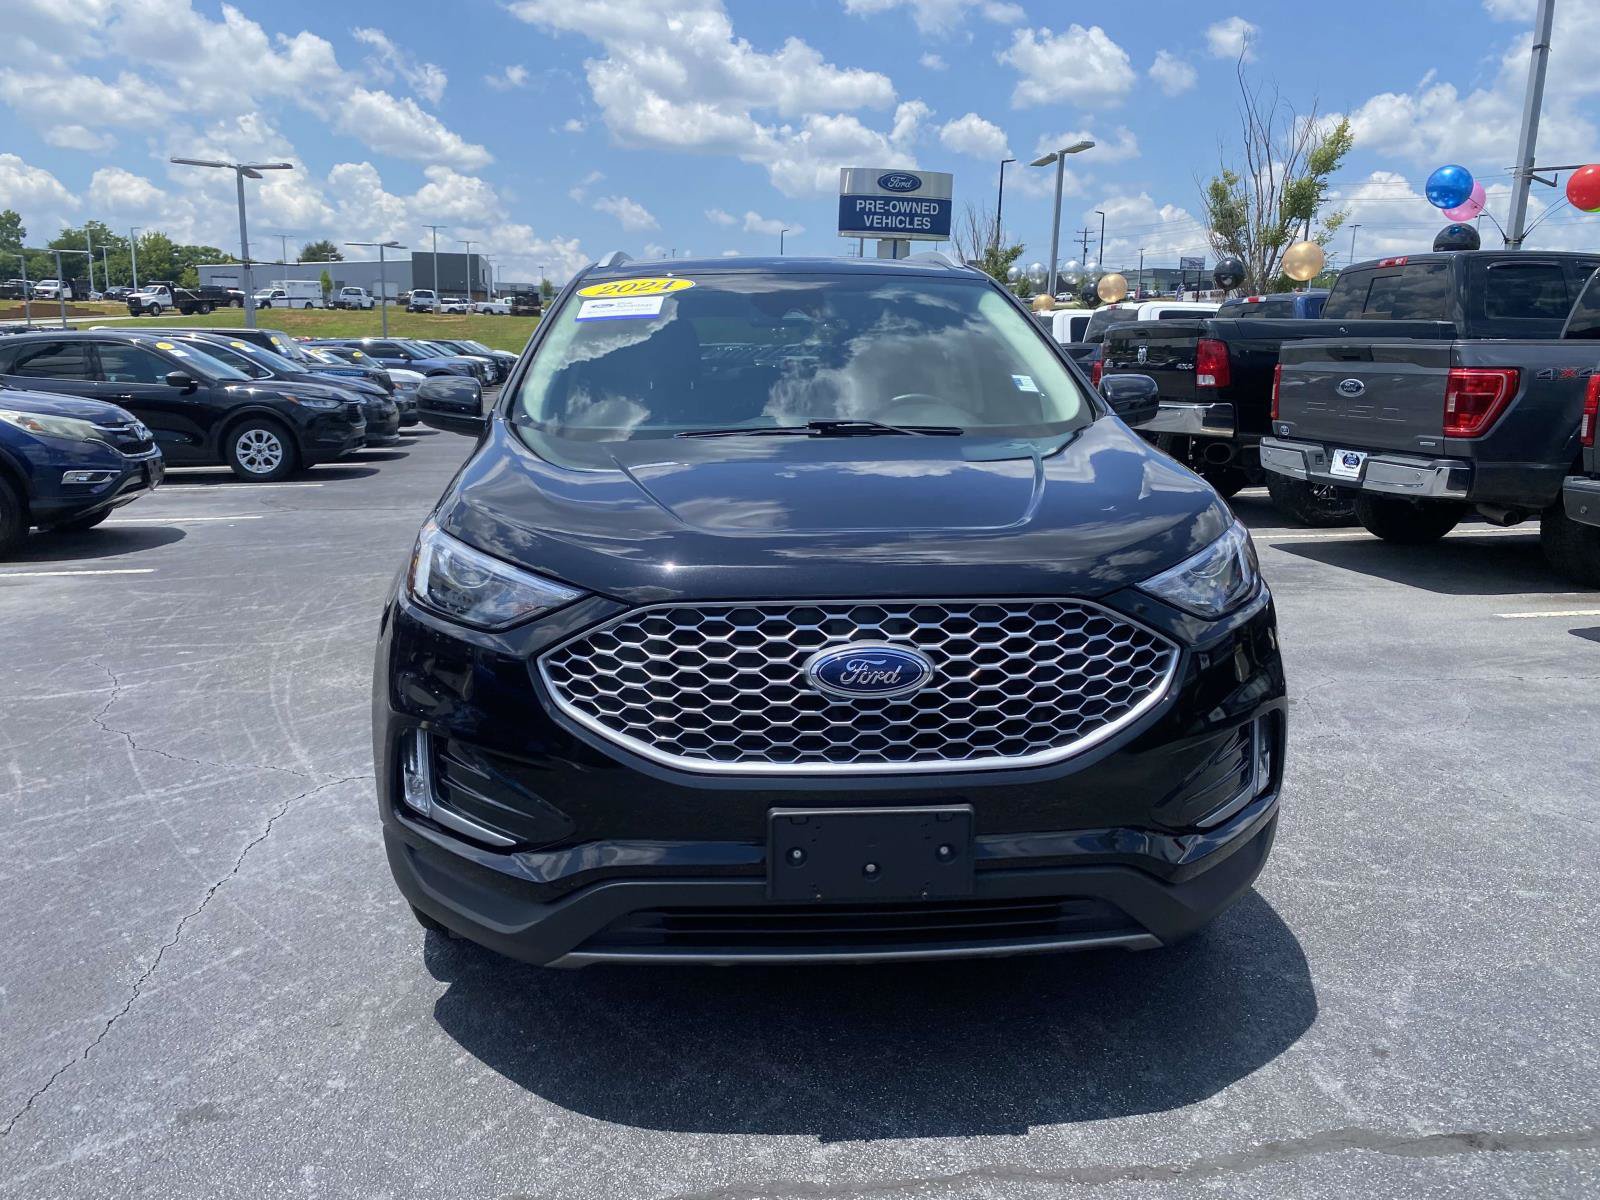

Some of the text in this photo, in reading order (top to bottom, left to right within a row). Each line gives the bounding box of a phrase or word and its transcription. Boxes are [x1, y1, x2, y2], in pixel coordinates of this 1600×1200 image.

[887, 176, 912, 188] Ford
[856, 200, 939, 215] PRE-OWNED
[864, 215, 931, 229] VEHICLES
[597, 280, 676, 295] 2024
[840, 659, 903, 685] Ford
